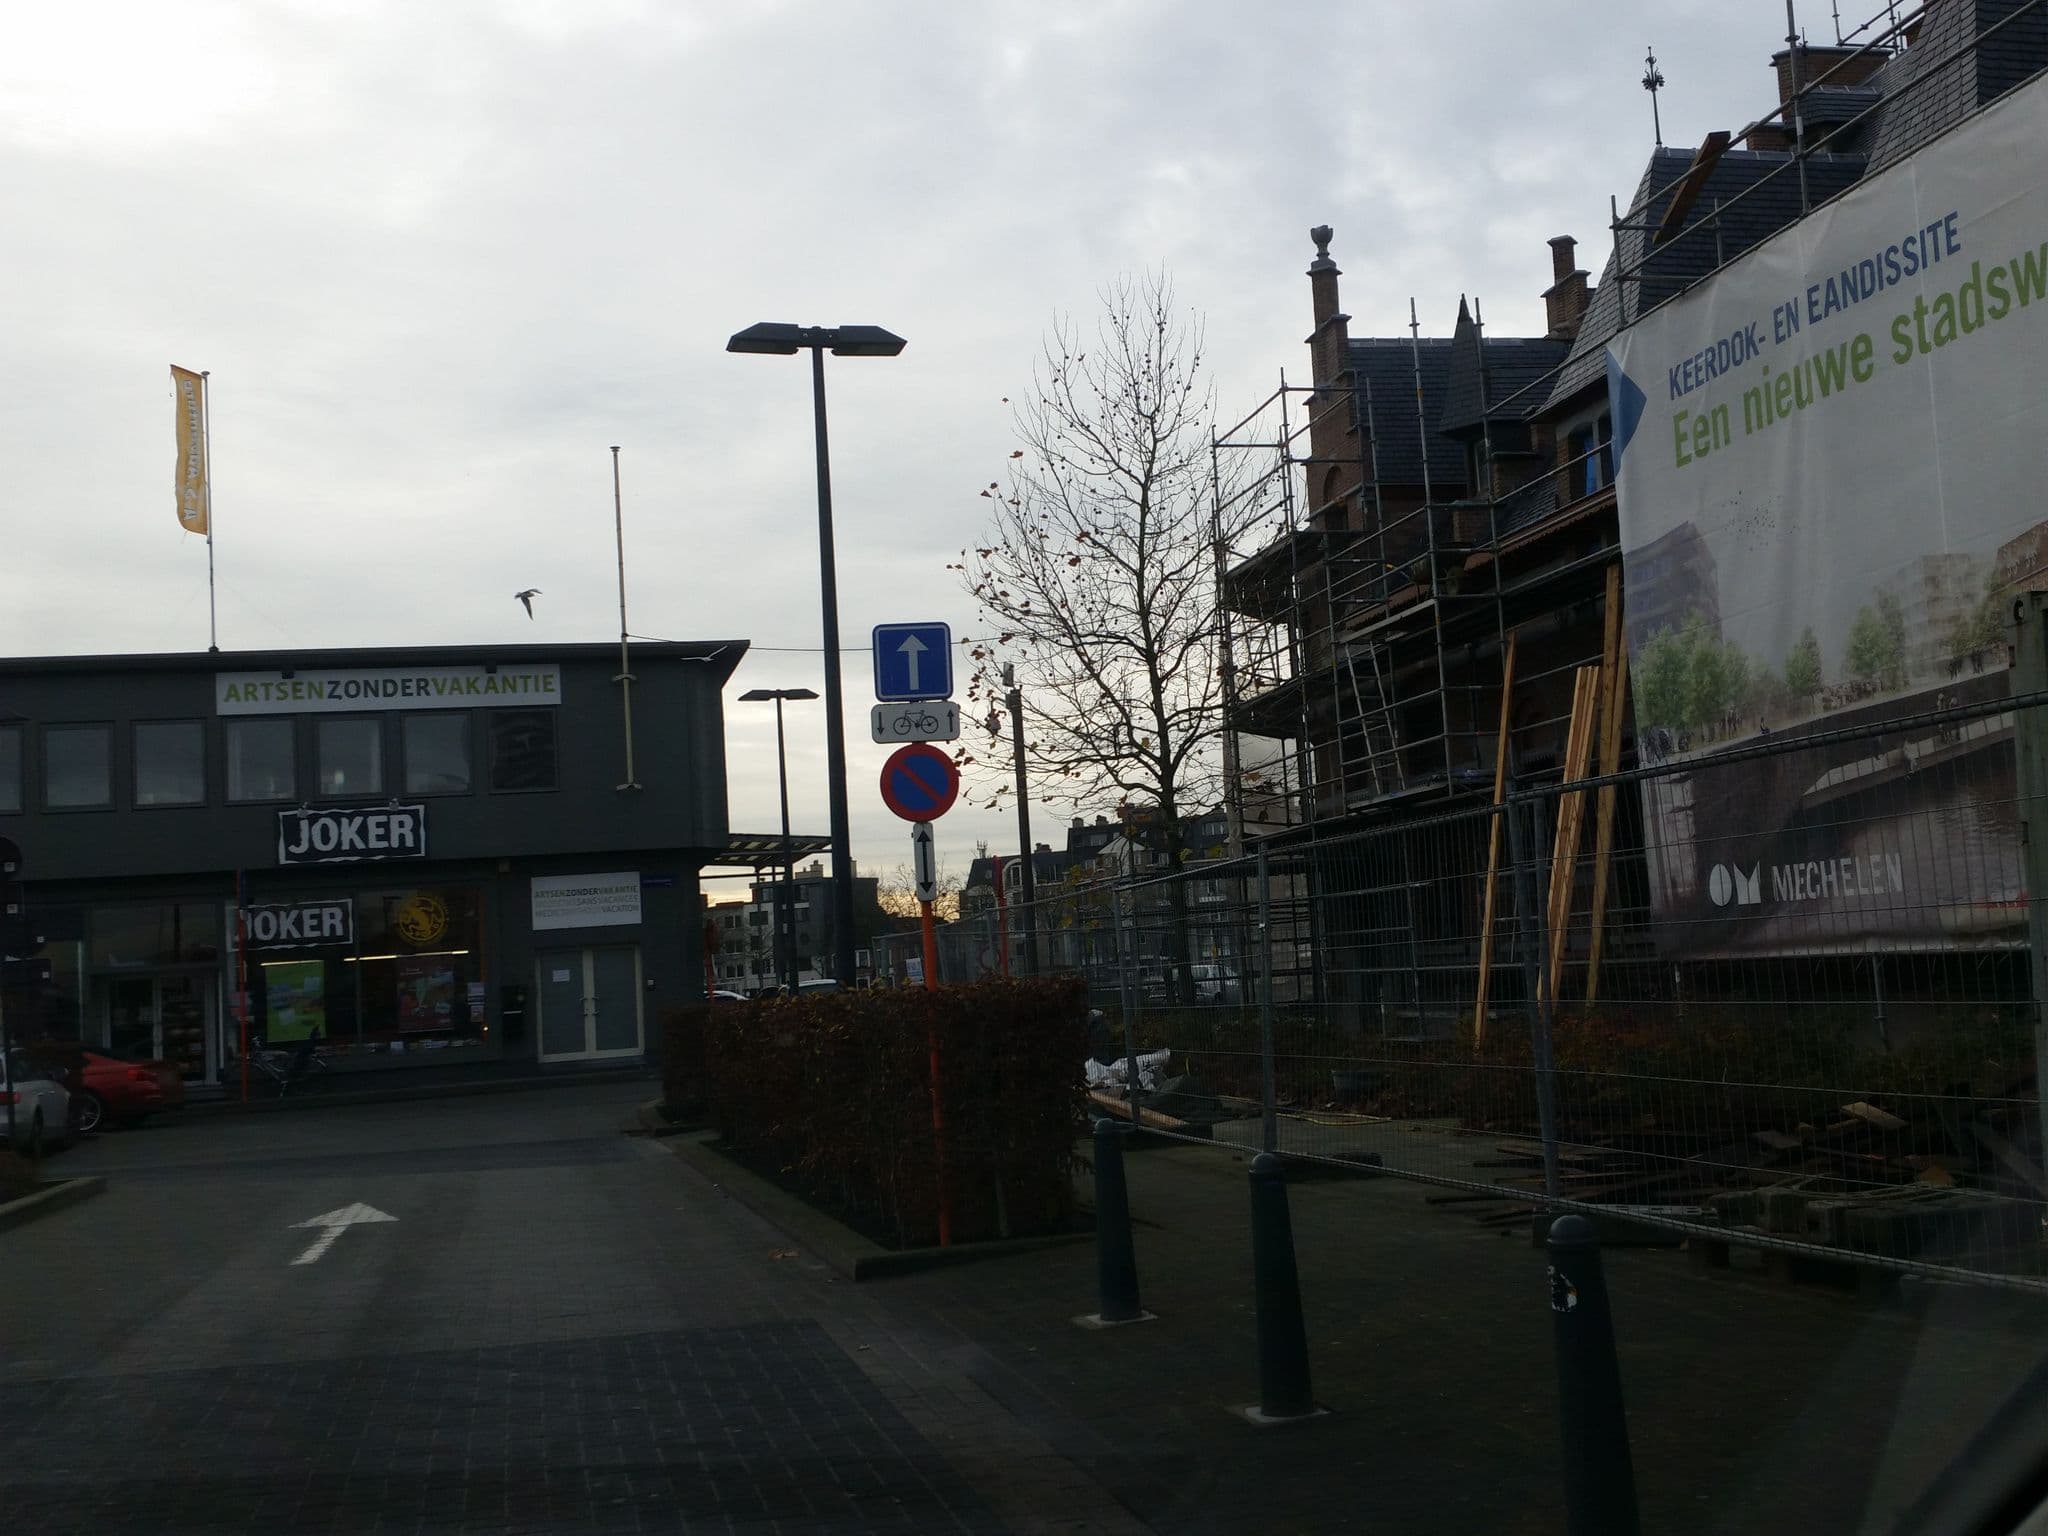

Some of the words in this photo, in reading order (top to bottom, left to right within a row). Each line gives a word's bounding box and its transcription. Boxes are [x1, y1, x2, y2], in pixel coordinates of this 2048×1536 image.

[1669, 321, 1766, 400] KEERDOK-
[1773, 297, 1800, 346] EN
[1807, 211, 1961, 325] EANDISSITE
[1673, 402, 1732, 468] Een
[1743, 332, 1875, 436] nieuwe
[1891, 241, 2048, 366] stadsw
[223, 673, 556, 703] ARTSENZONDERVAKANTIE
[288, 813, 416, 855] JOKER
[1770, 852, 1904, 902] MECHELEN
